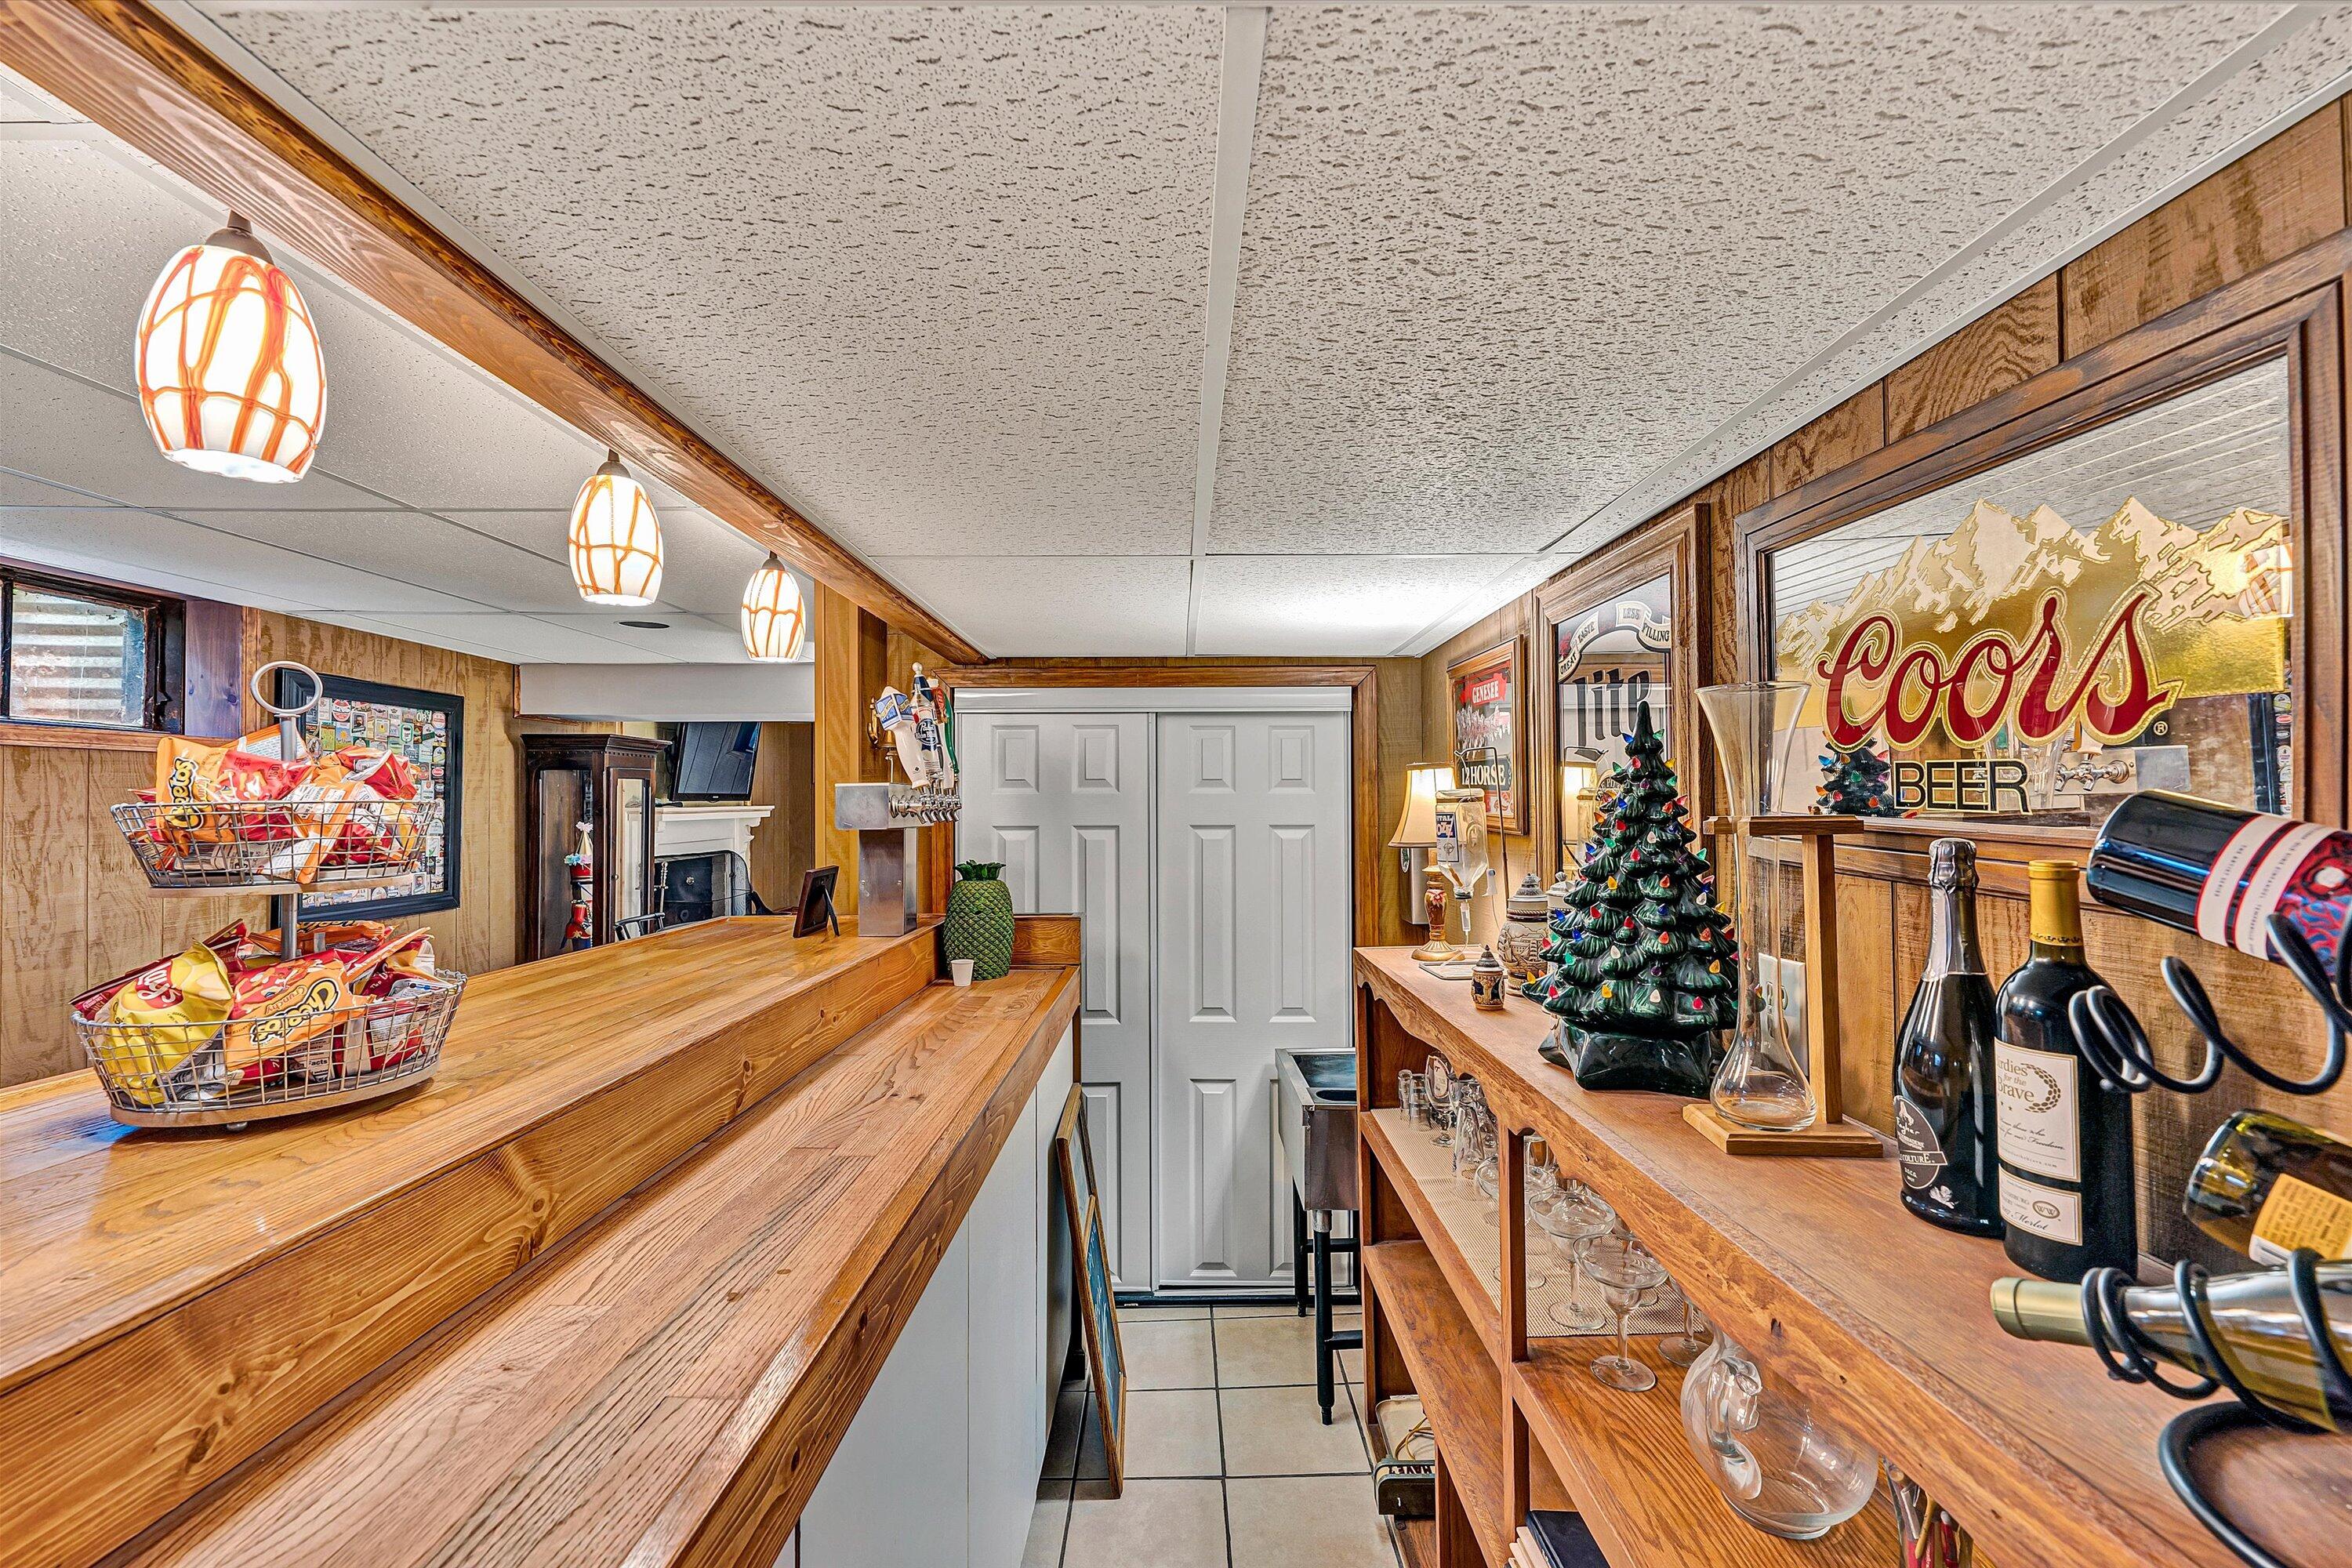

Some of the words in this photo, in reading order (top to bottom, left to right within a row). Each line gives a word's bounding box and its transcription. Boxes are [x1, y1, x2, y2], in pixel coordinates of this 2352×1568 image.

[1623, 607, 1640, 619] LESS
[1642, 622, 1670, 642] FILLING
[1559, 651, 1577, 675] GREAT
[1578, 621, 1595, 644] TASTE
[1814, 583, 2183, 752] Coors
[1472, 680, 1500, 704] GENESEE
[1470, 764, 1506, 786] HORSE
[1893, 757, 2032, 815] BEER
[136, 961, 181, 1004] Lay's
[252, 979, 339, 1043] Cheetos
[265, 985, 307, 1015] Crunchy
[1998, 1055, 2029, 1077] irdies
[1998, 1076, 2035, 1103] Brave
[2014, 1077, 2027, 1087] the
[2011, 1211, 2049, 1231] Merlot
